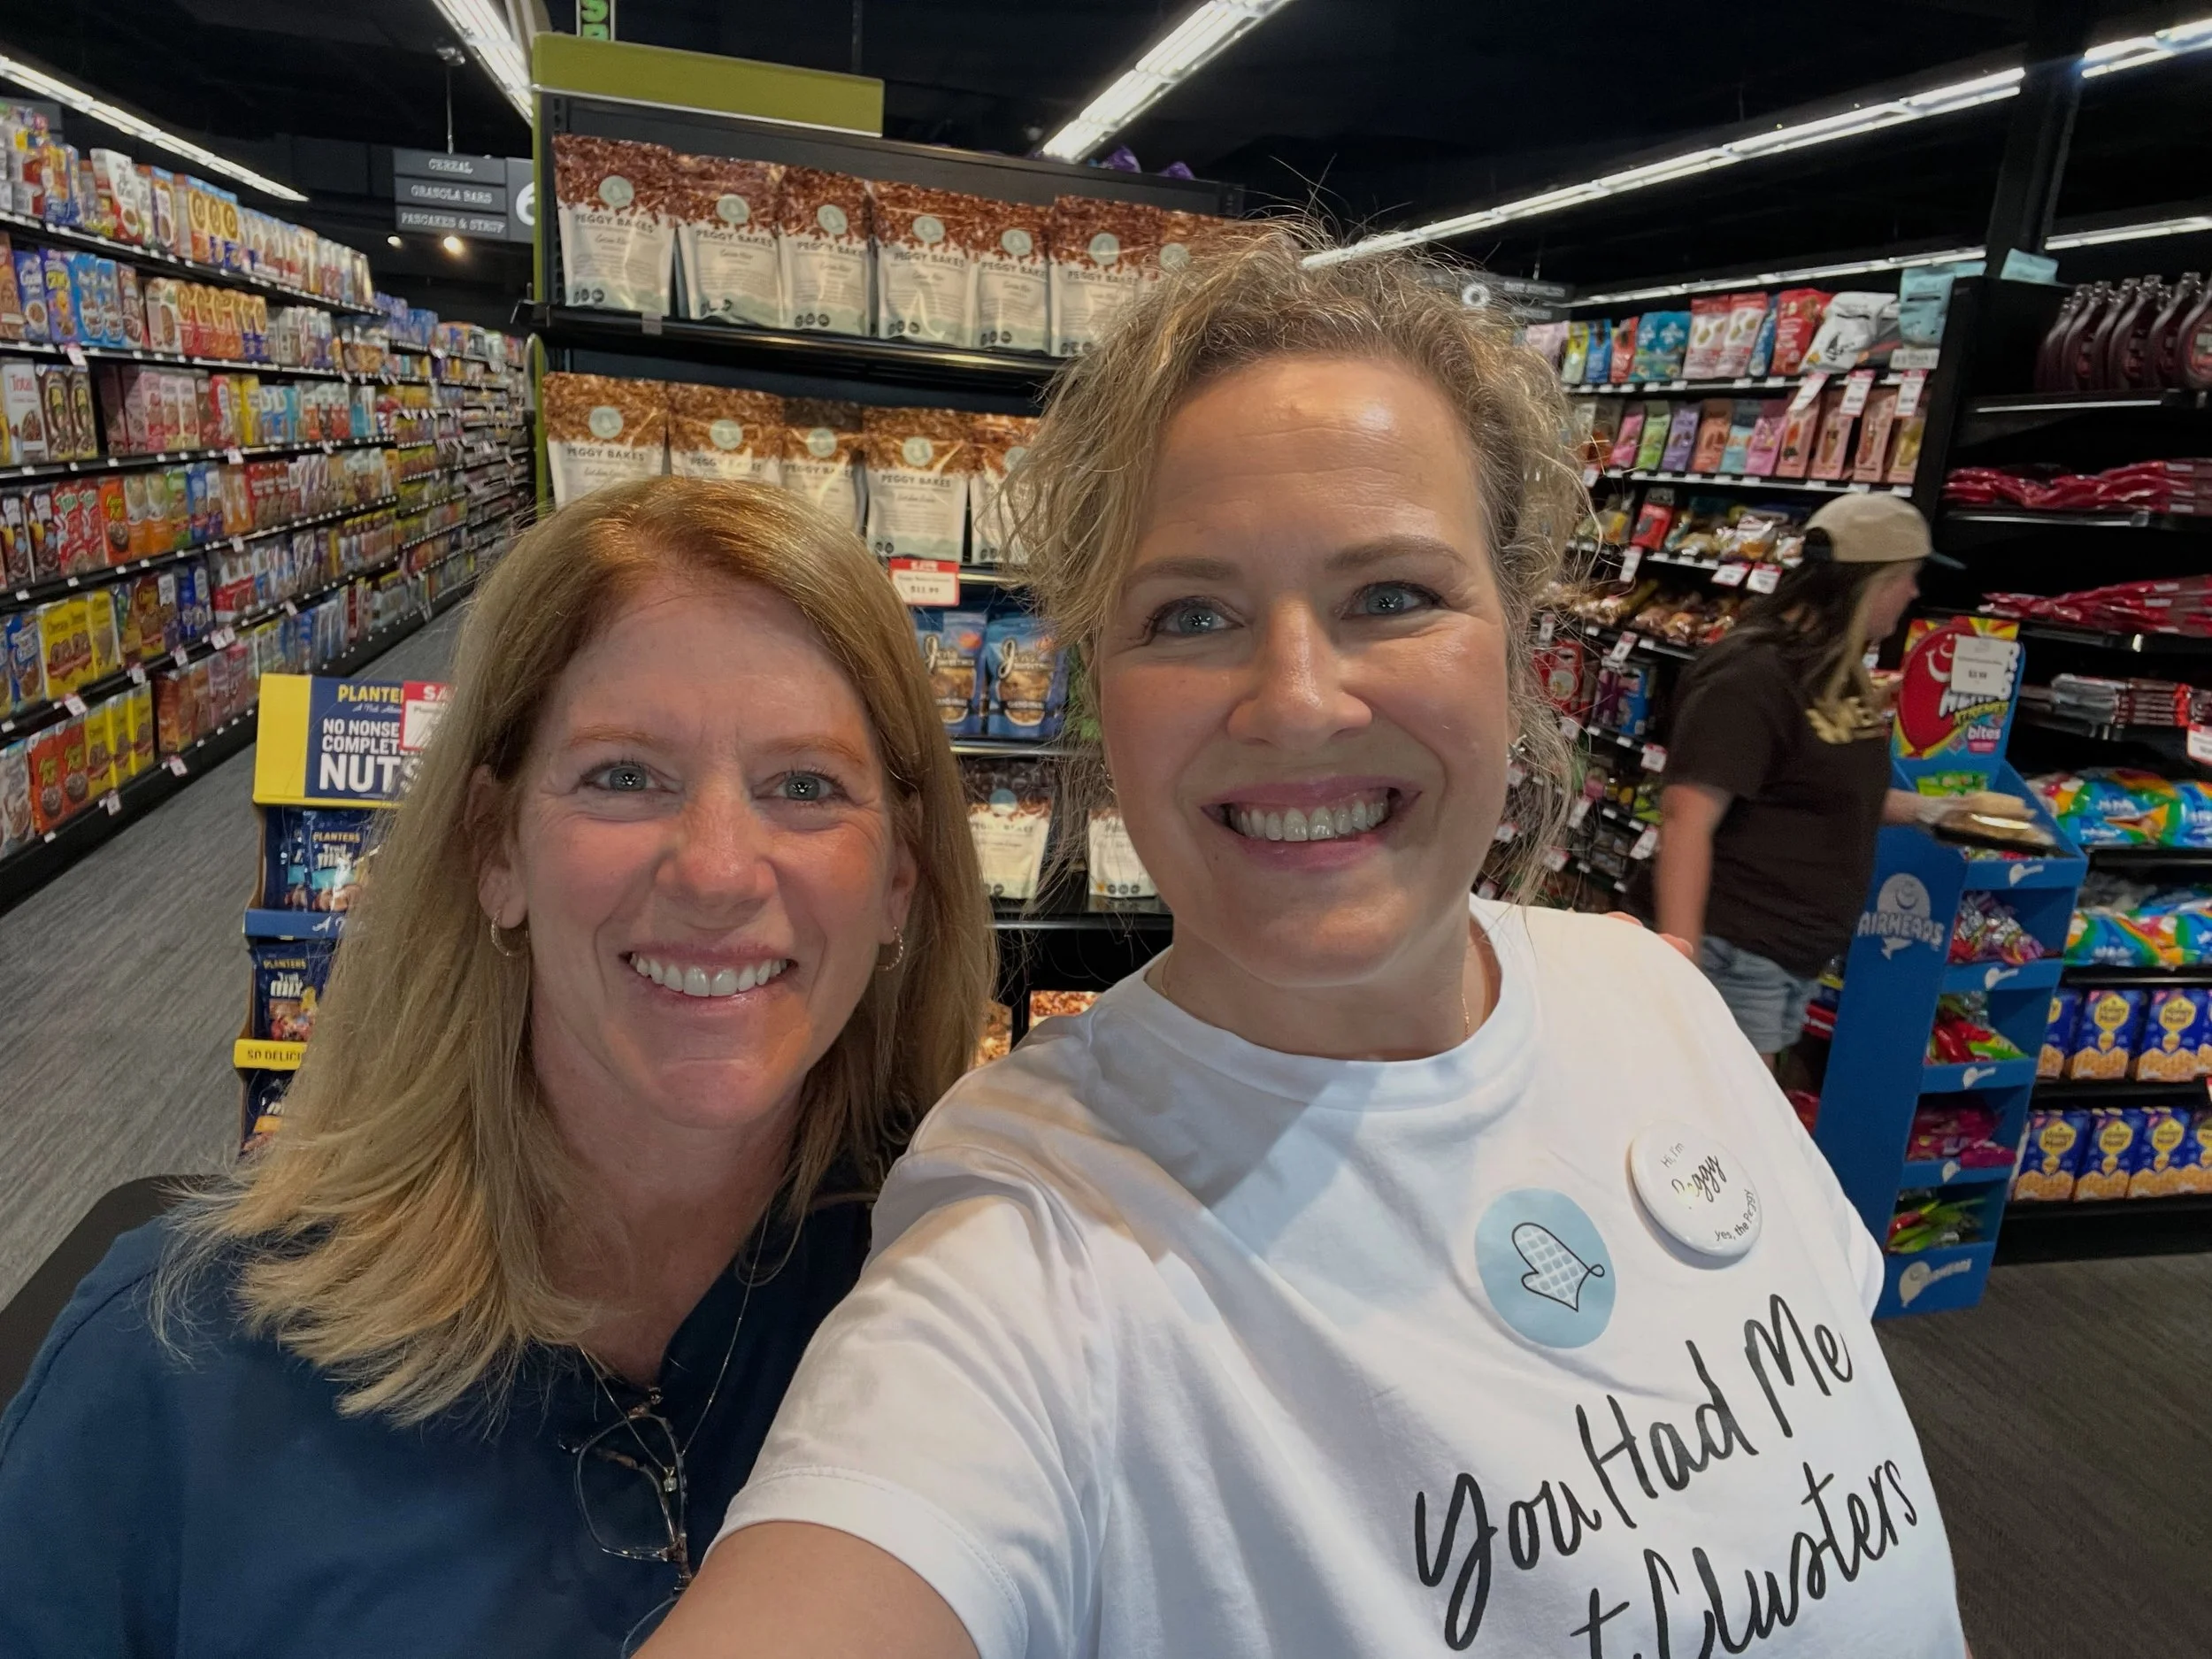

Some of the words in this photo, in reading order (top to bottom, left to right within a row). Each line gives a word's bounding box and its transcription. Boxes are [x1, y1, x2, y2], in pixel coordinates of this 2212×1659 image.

[411, 185, 460, 202] GRANOLA
[464, 191, 493, 204] BARS
[574, 213, 613, 226] PEGGY
[695, 229, 734, 242] PEGGY
[738, 234, 774, 248] BAKES
[893, 251, 928, 263] PEGGY
[931, 254, 965, 267] BAKES
[566, 447, 604, 458] PEGGY
[607, 449, 645, 463] BAKES
[881, 473, 916, 485] PEGGY
[918, 476, 951, 488] BAKES
[338, 684, 404, 703] PLANTE
[323, 718, 345, 735] NO
[349, 719, 401, 738] NONSE
[1968, 725, 2002, 741] bites
[322, 735, 409, 757] COMPLET
[1857, 910, 1945, 952] AIRHEADS
[248, 1048, 262, 1060] SO
[265, 1048, 301, 1061] DELICI
[1671, 1155, 1727, 1209] Pggy
[1733, 1224, 1750, 1237] the
[1416, 1472, 1602, 1652] You
[1575, 1340, 1760, 1529] Had
[1744, 1294, 1854, 1439] Me
[1643, 1460, 1918, 1659] Clusters
